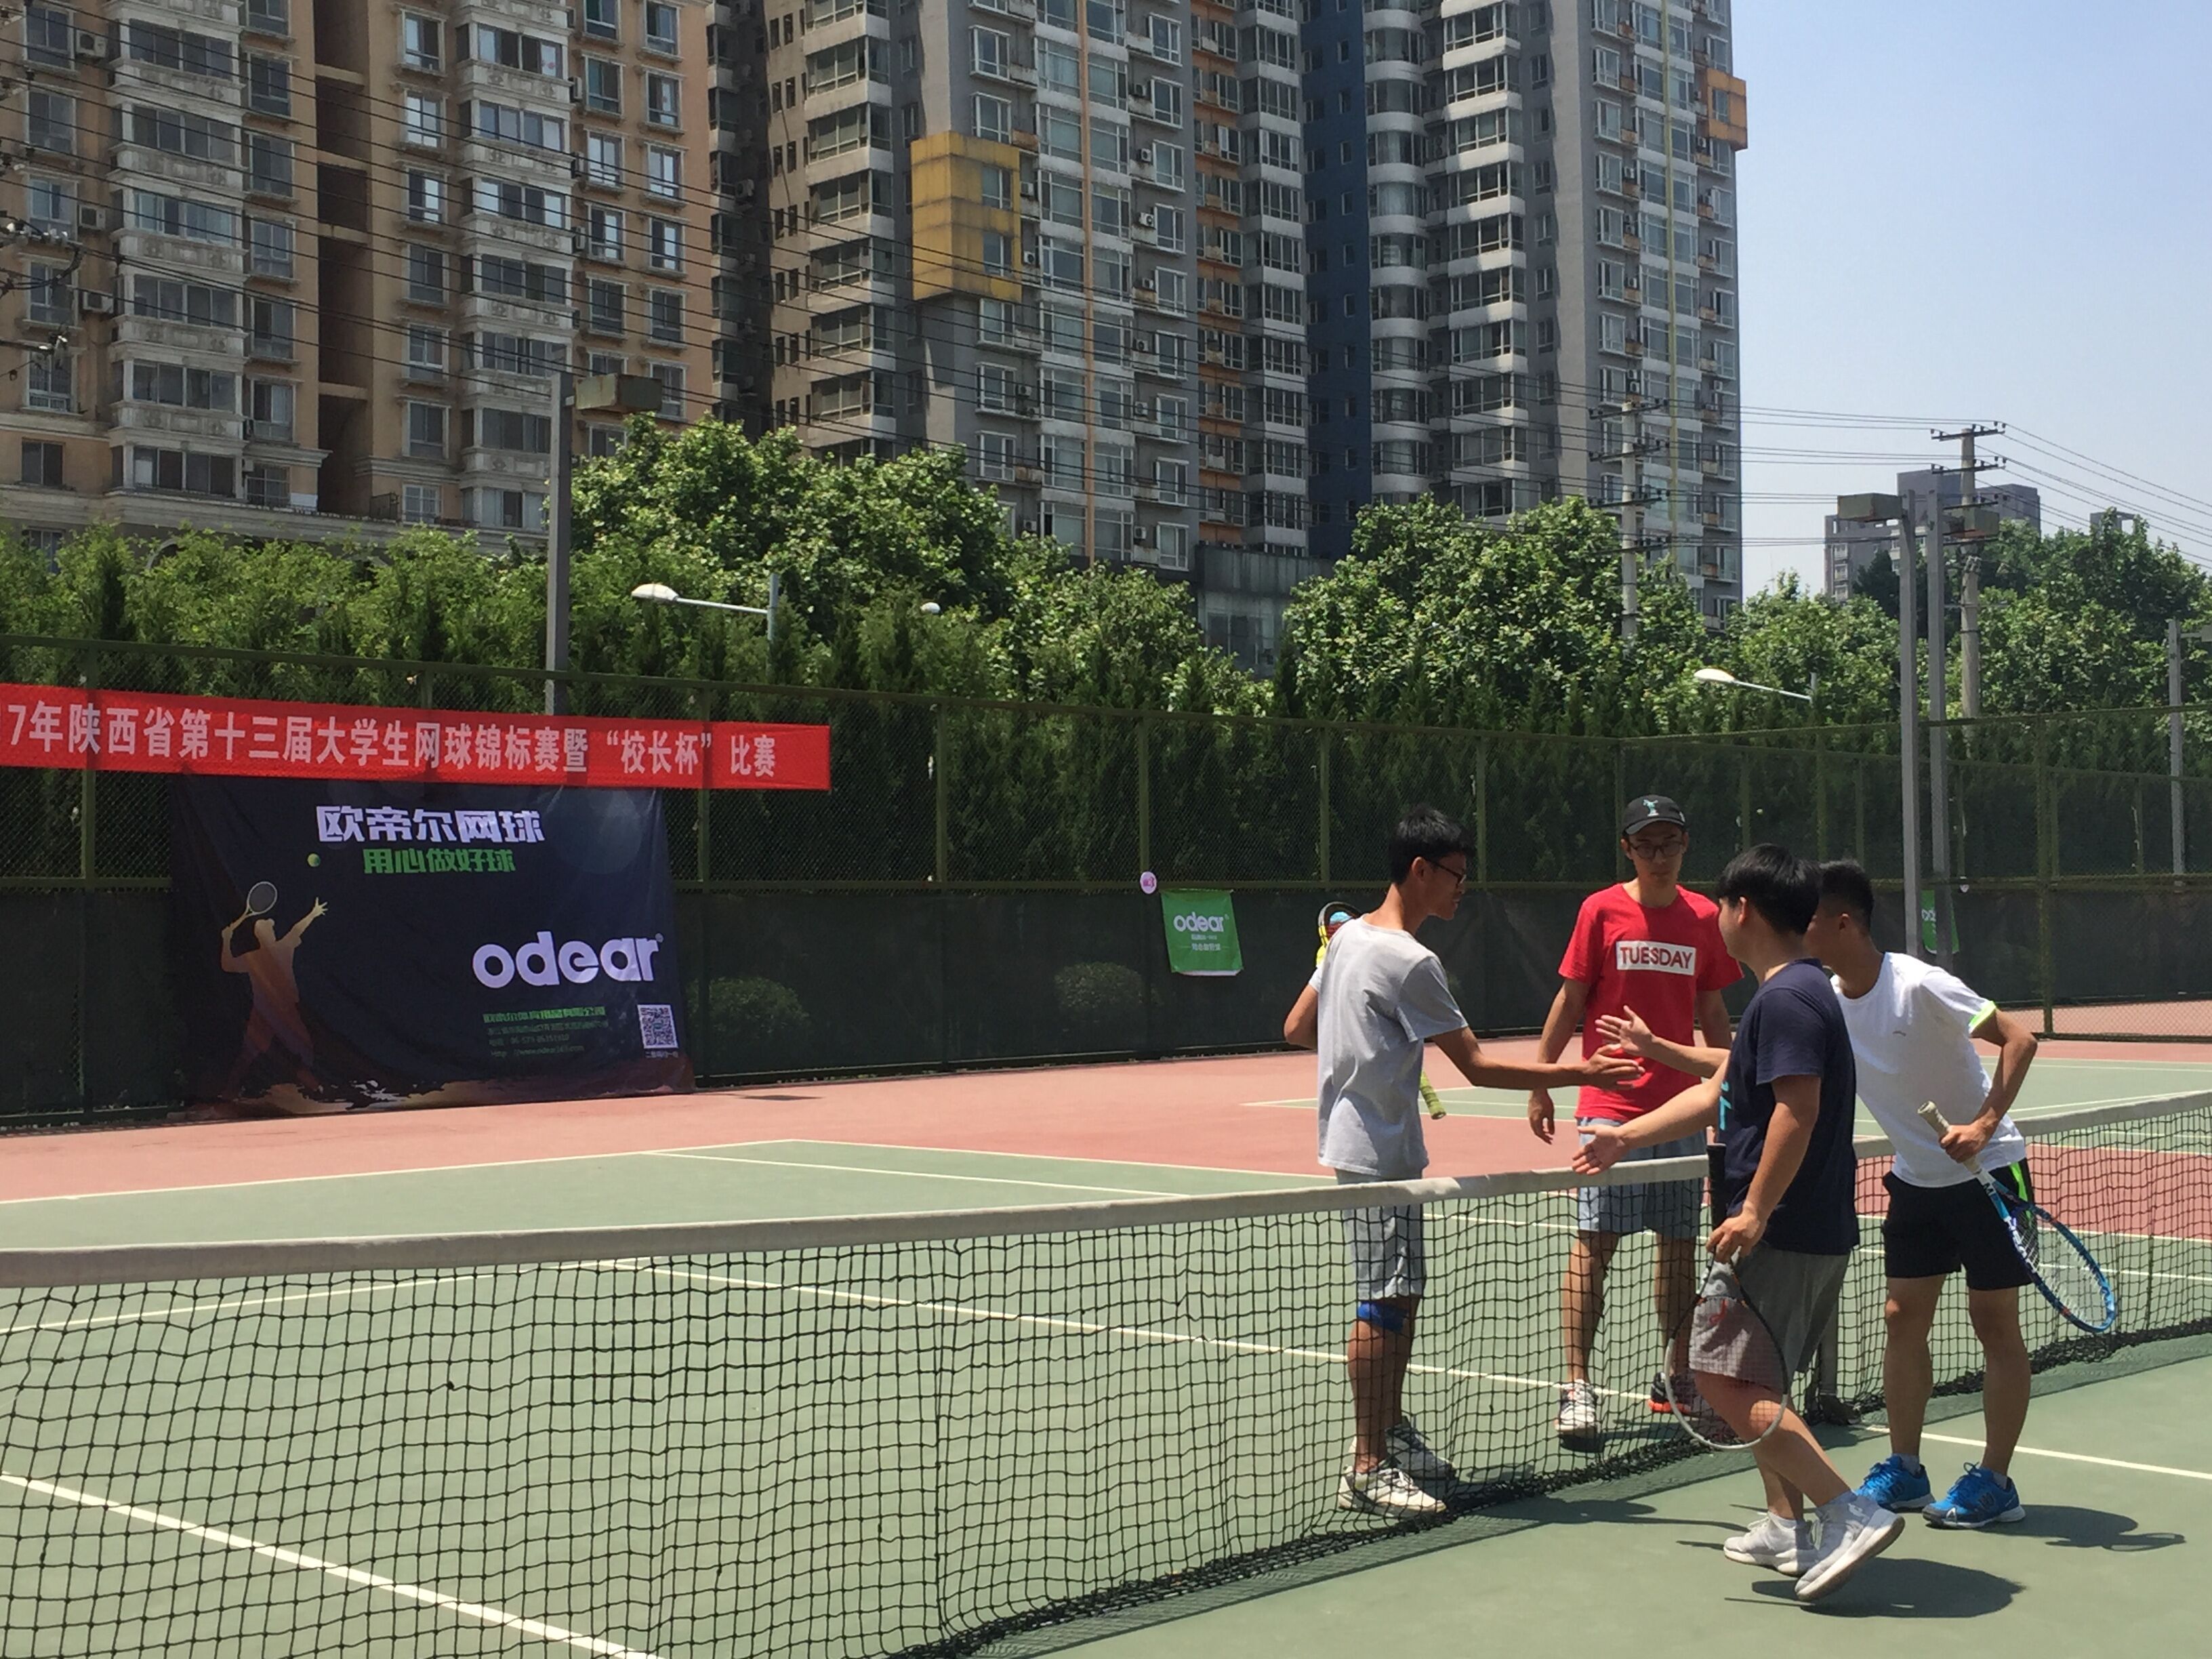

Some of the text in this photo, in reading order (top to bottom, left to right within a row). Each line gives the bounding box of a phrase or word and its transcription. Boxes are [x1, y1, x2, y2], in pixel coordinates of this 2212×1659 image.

[316, 805, 545, 843] 欧帝尔网球
[363, 847, 516, 874] 用心做好球
[1173, 911, 1224, 933] odear
[472, 930, 659, 989] odear
[1620, 946, 1693, 969] TUESDAY
